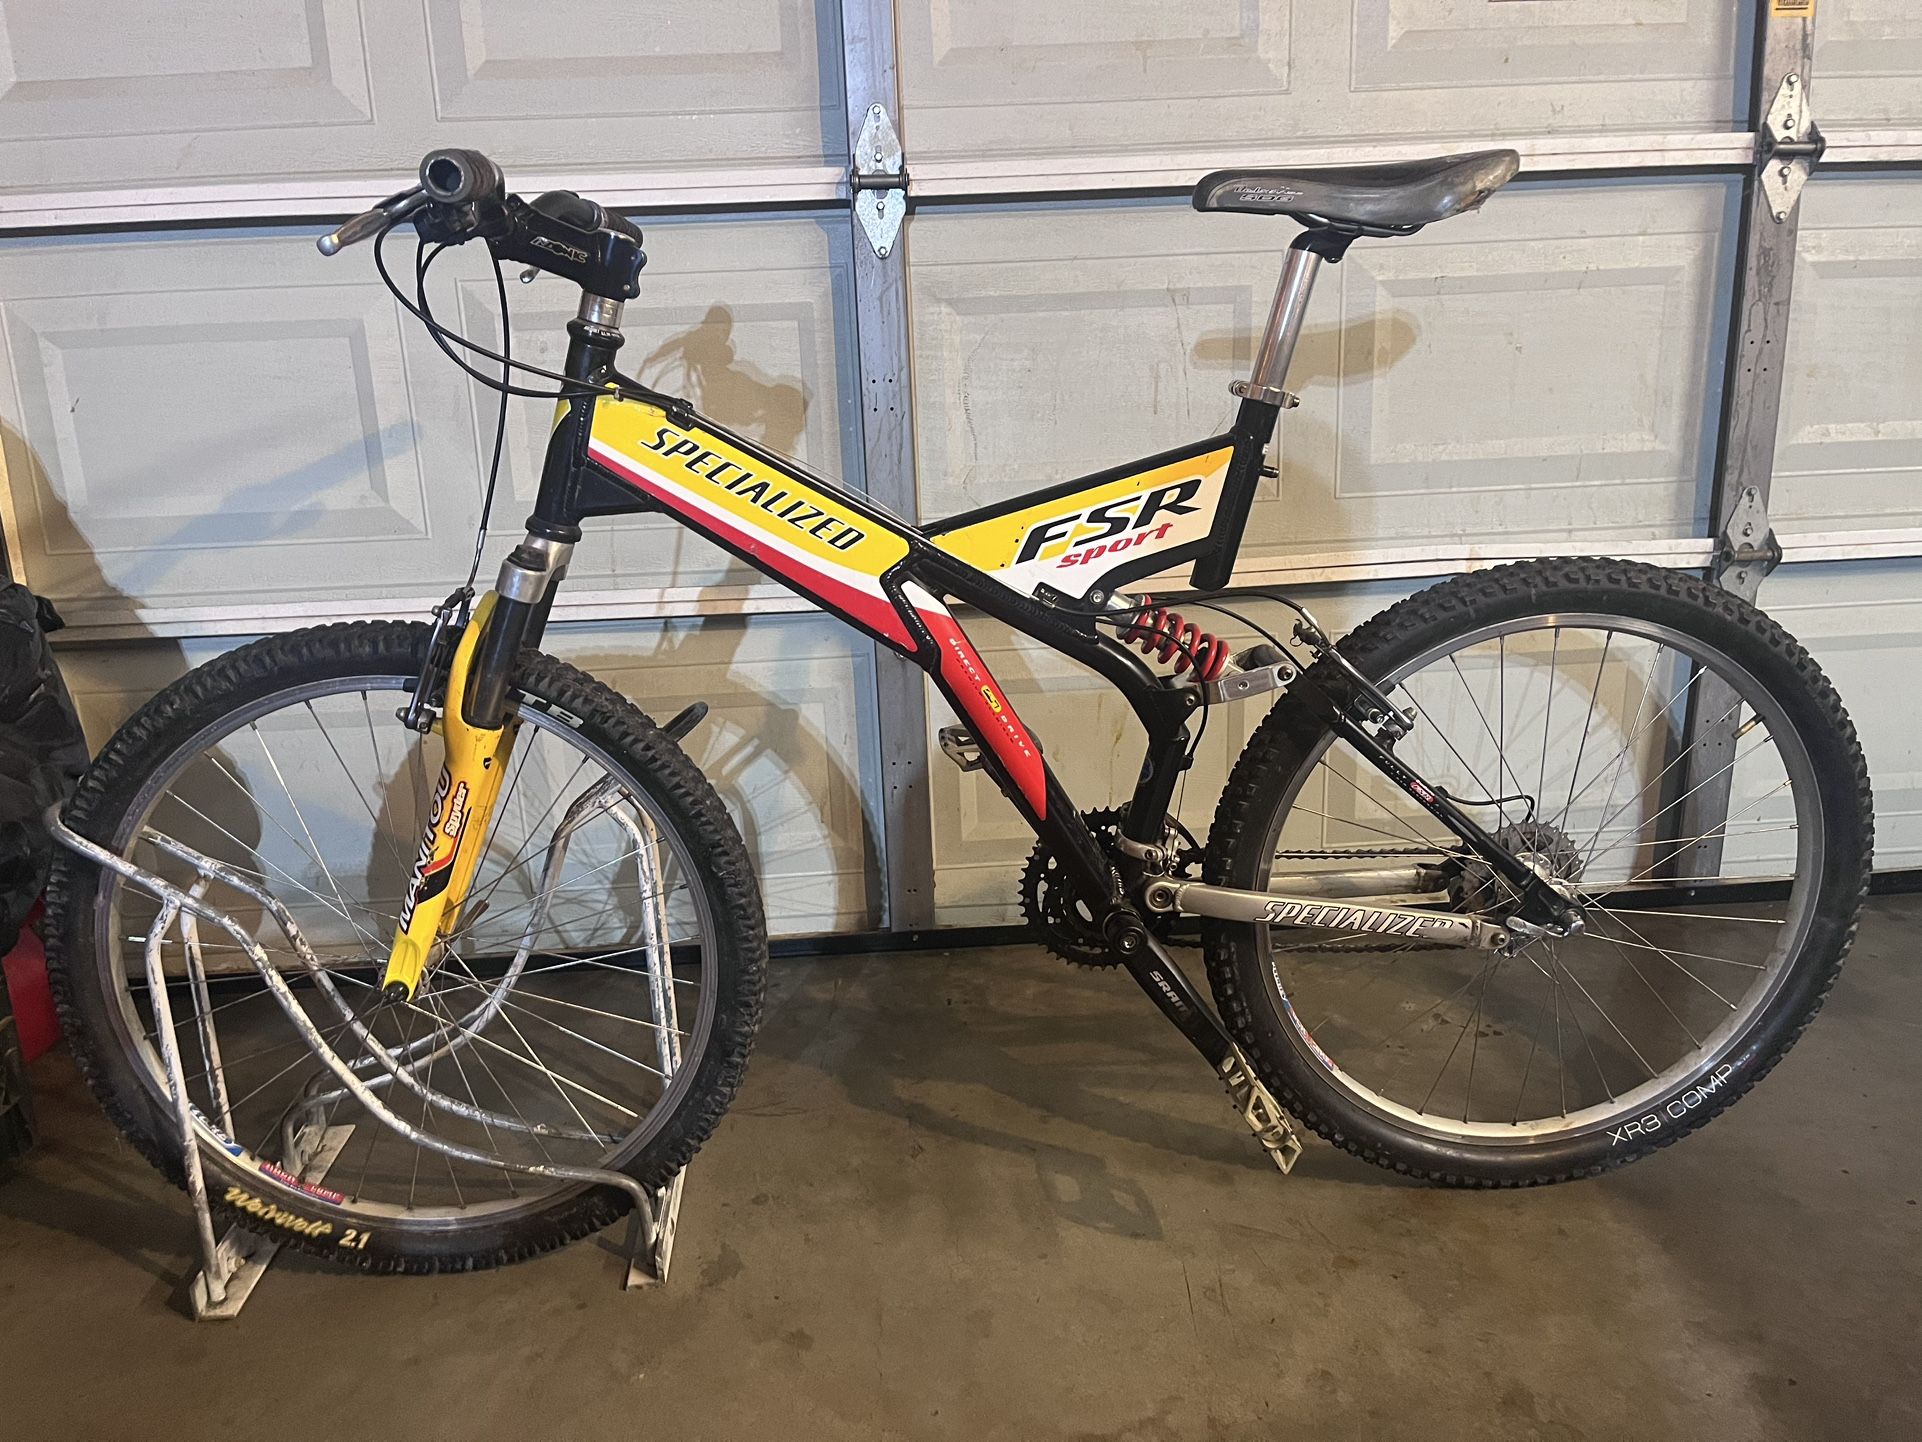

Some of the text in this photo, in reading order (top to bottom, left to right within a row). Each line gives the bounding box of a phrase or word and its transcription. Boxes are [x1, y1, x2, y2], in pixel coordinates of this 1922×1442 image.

[640, 427, 865, 552] SPECIALIZED
[1014, 478, 1202, 564] FSR
[1056, 521, 1174, 569] sport
[399, 767, 452, 934] MANITOU
[444, 783, 467, 837] Spyder
[1606, 1063, 1732, 1146] XR3 COMP
